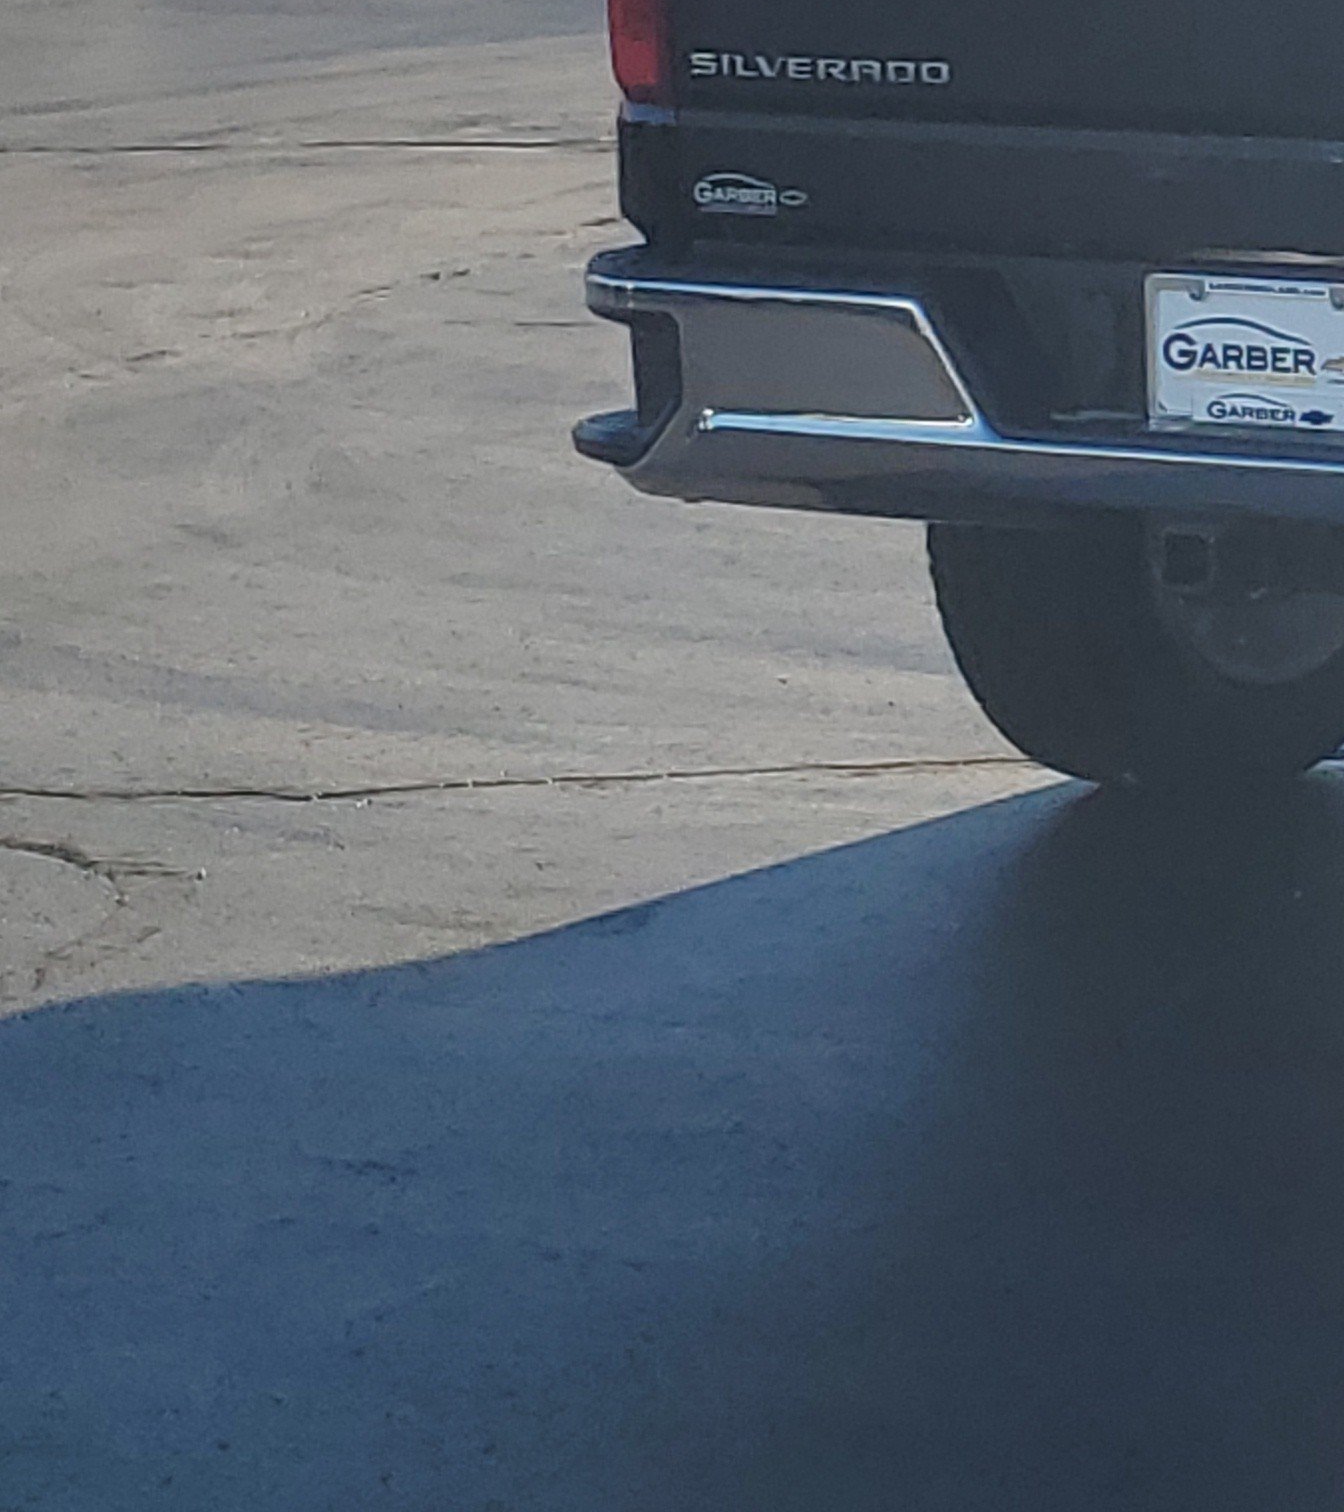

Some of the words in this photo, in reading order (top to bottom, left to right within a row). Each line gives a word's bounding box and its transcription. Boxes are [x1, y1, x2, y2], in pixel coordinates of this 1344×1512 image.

[690, 51, 950, 85] SILVERADO
[693, 180, 778, 205] GARBER
[1162, 332, 1318, 376] GARBER
[1206, 400, 1297, 424] GARBER
